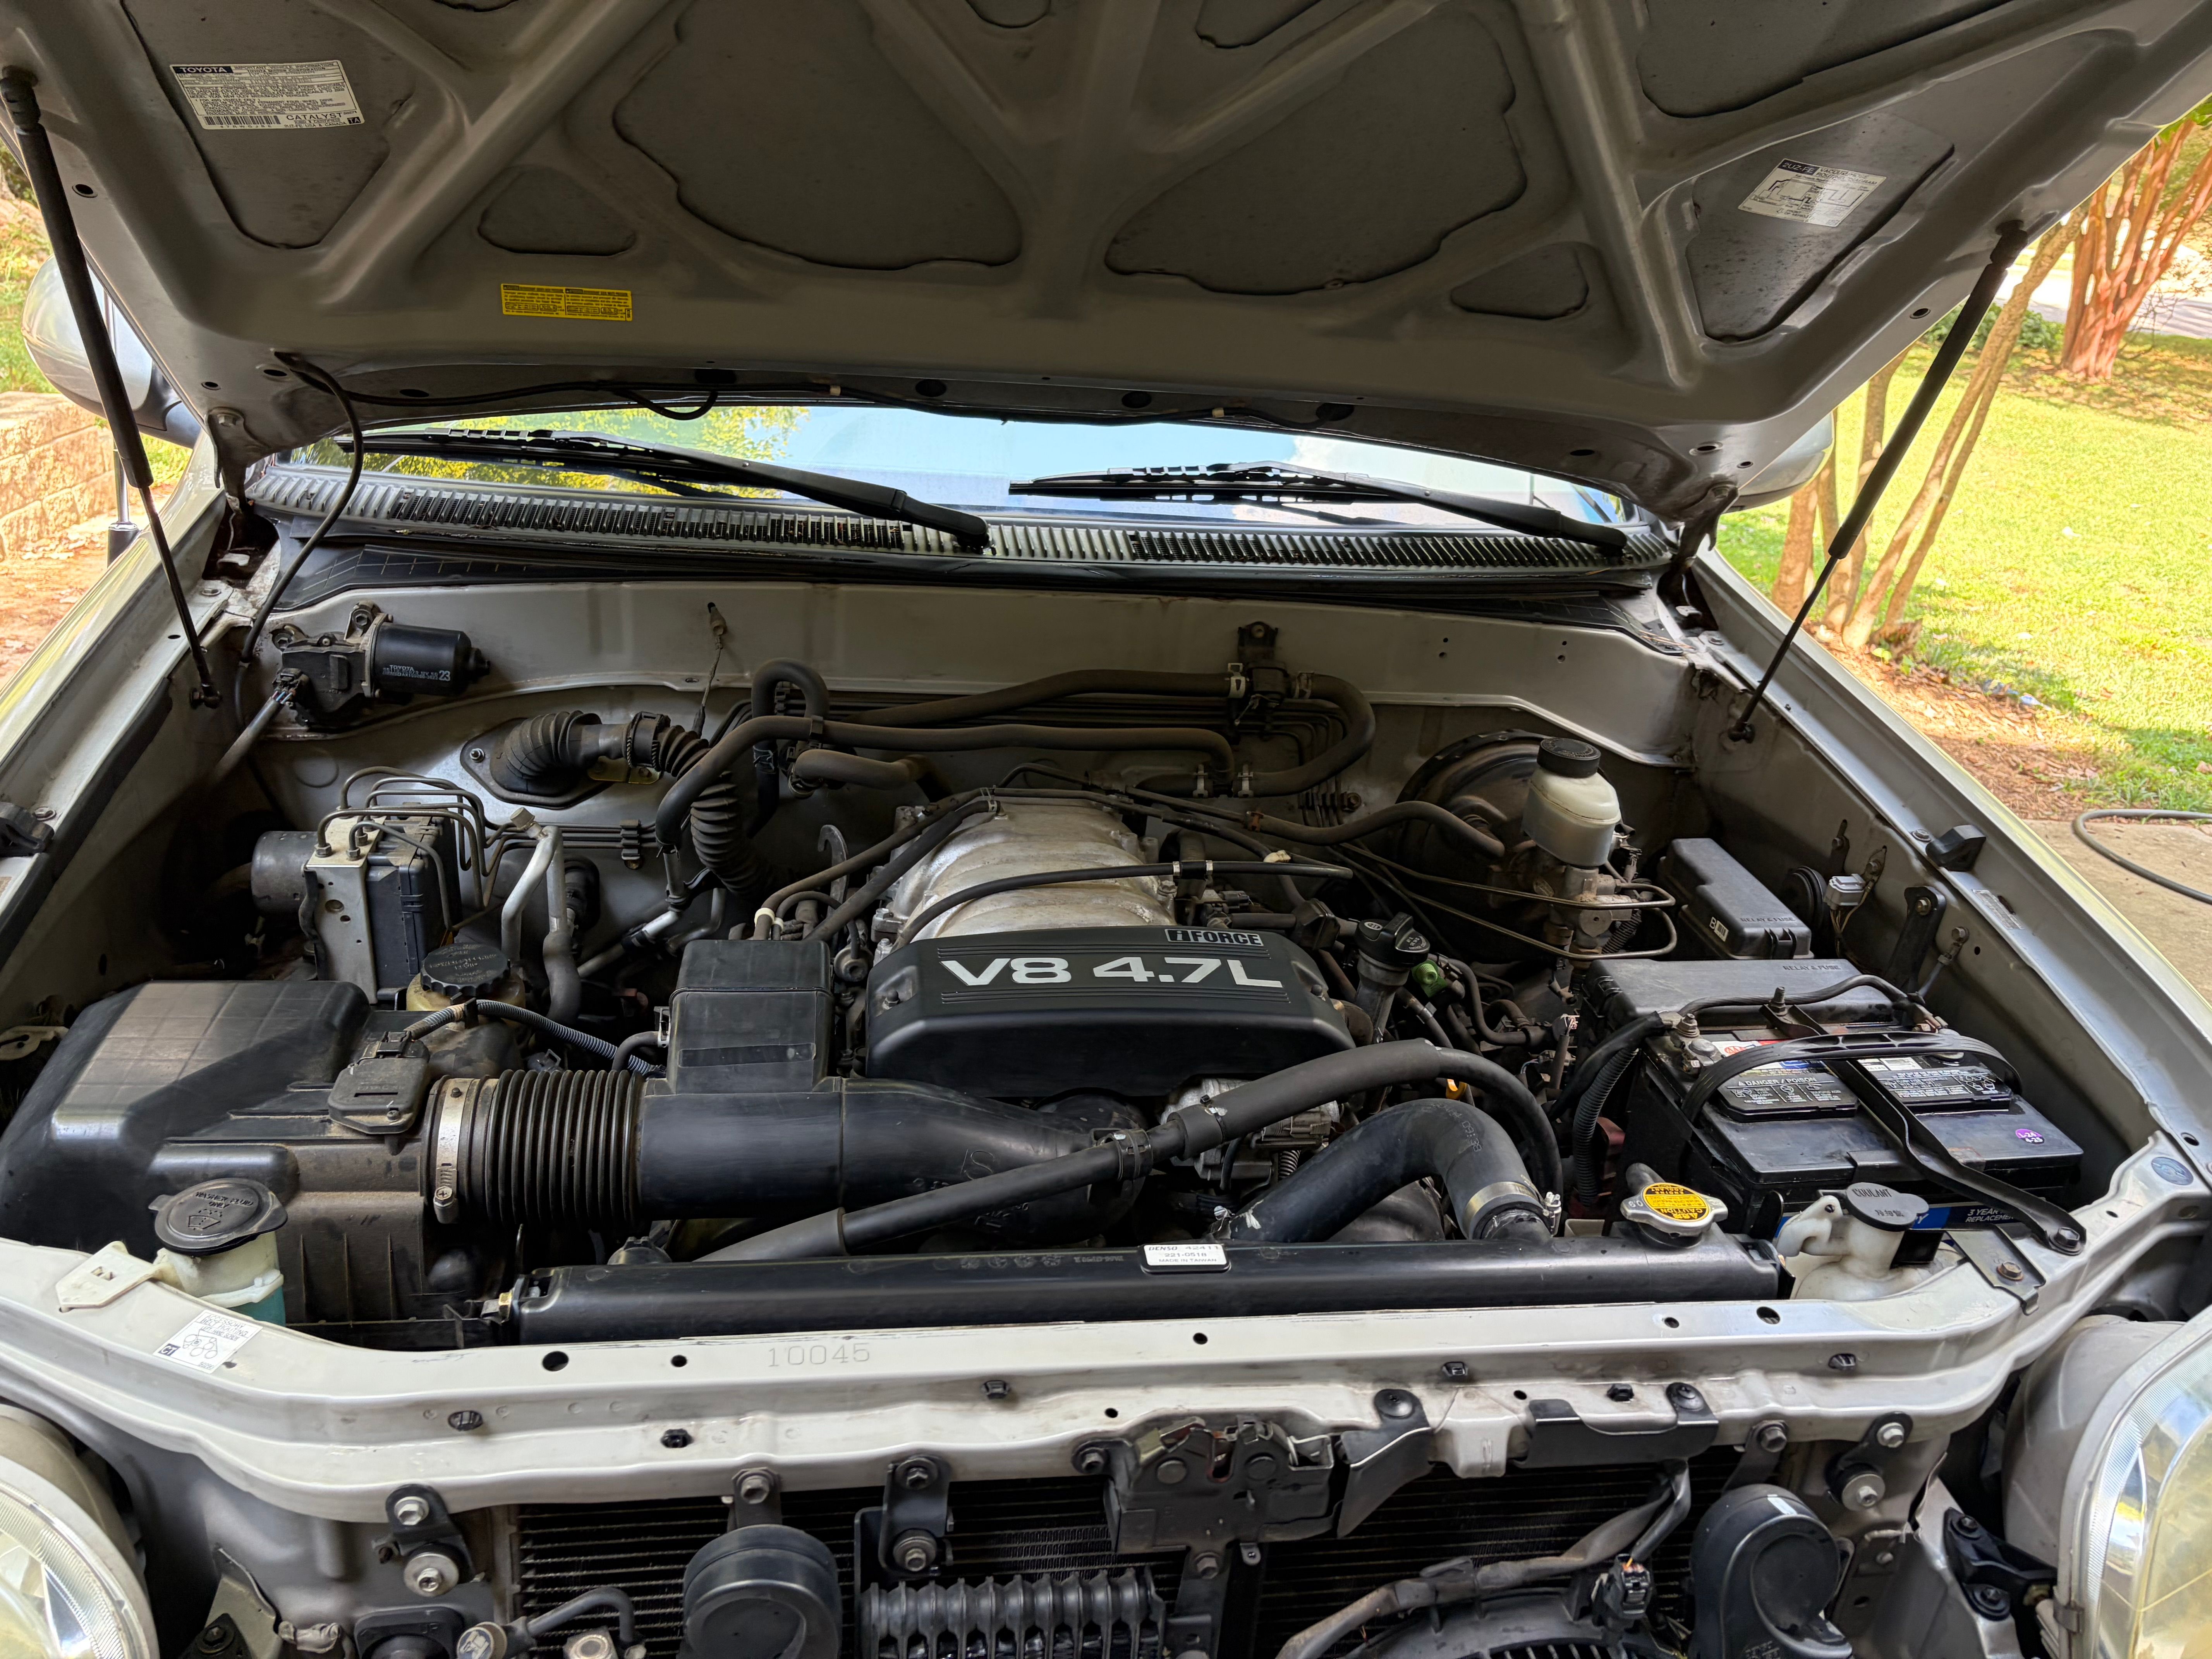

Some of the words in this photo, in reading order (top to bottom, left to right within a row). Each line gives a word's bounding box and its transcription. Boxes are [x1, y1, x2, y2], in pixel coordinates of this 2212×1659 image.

[286, 112, 344, 120] CATALYST
[1782, 162, 1816, 173] 2UZ-FE
[439, 670, 451, 682] 23
[1709, 916, 1717, 929] B
[939, 957, 1072, 986] V8
[1093, 956, 1283, 988] 4.7L
[195, 1191, 228, 1201] WASHER
[230, 1198, 254, 1206] FLUID
[200, 1318, 218, 1327] BELT
[218, 1323, 249, 1337] ROUTING
[205, 1314, 246, 1329] ACCESSORY
[161, 1345, 179, 1356] CT
[768, 1342, 870, 1367] 10045
